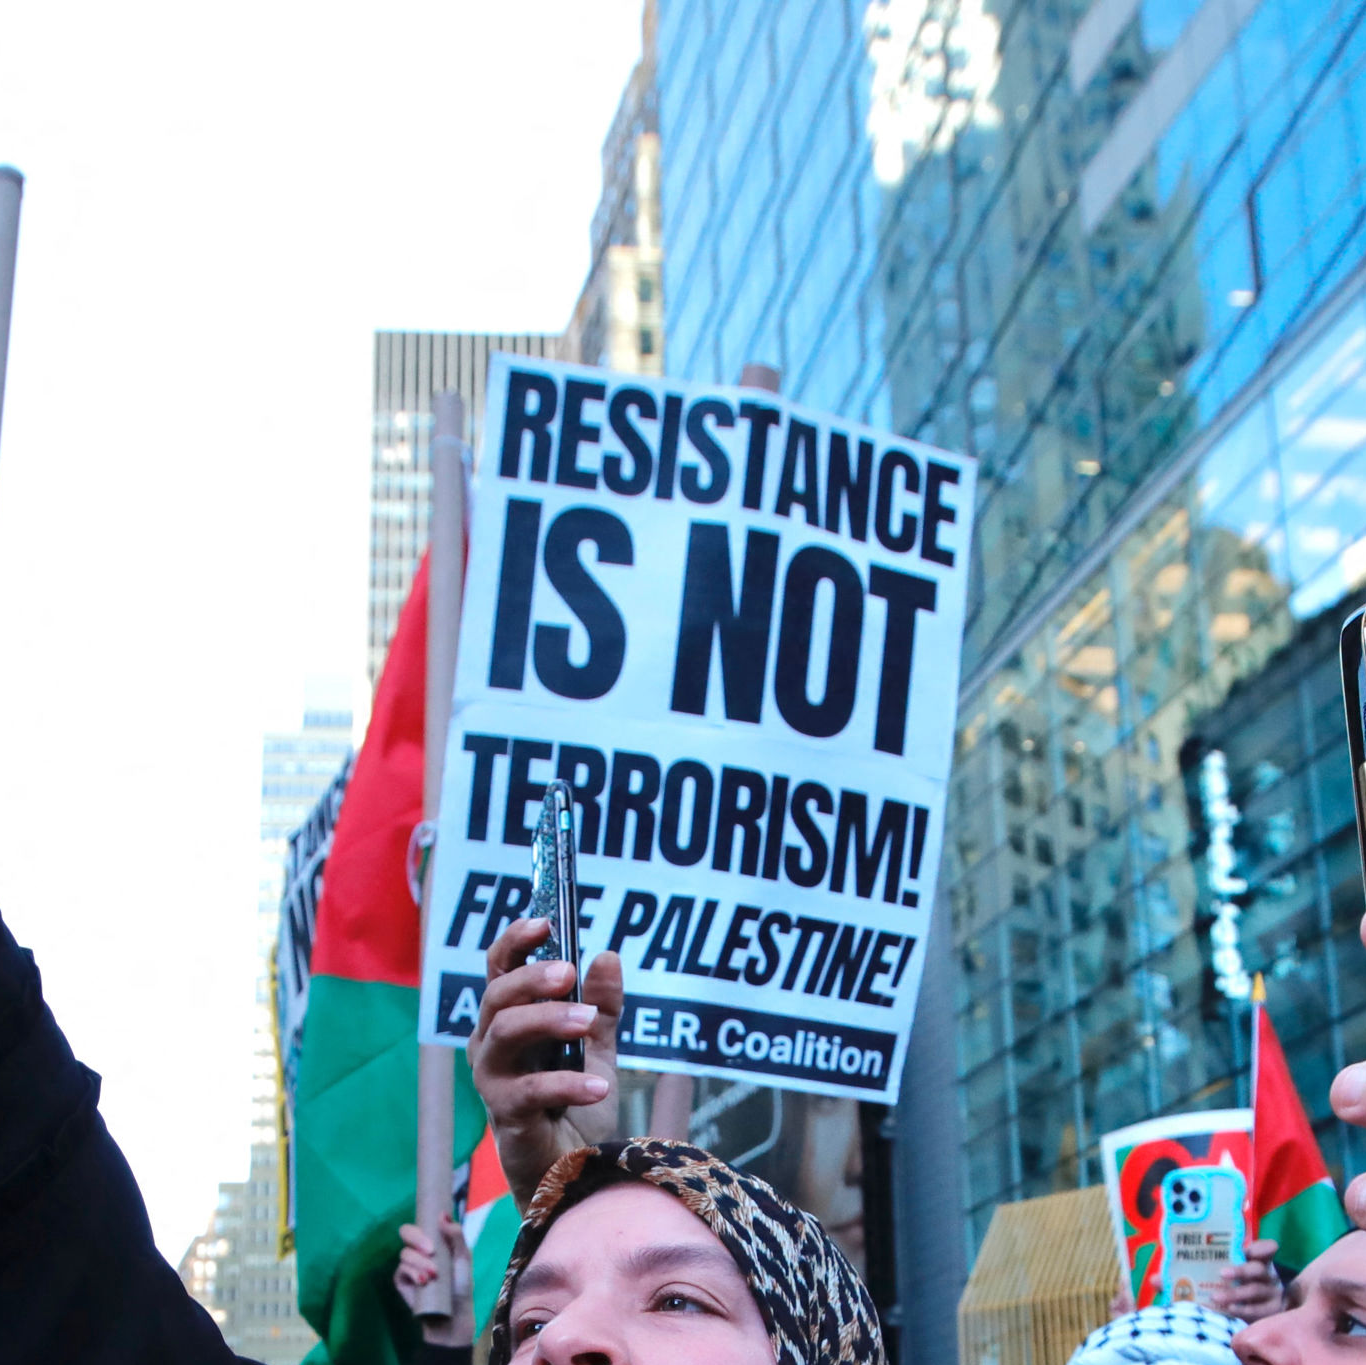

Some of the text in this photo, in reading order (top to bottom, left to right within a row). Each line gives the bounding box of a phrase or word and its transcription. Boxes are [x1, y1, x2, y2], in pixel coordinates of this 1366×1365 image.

[499, 369, 961, 569] RESISTANCE
[488, 496, 938, 758] IS NOT
[463, 732, 930, 908] TERRORISM!
[445, 870, 605, 962] FRE
[605, 888, 917, 1008] PALESTINE!
[716, 1018, 883, 1078] Coalition
[1176, 1231, 1202, 1246] FREE
[1176, 1248, 1230, 1261] PALESTINE
